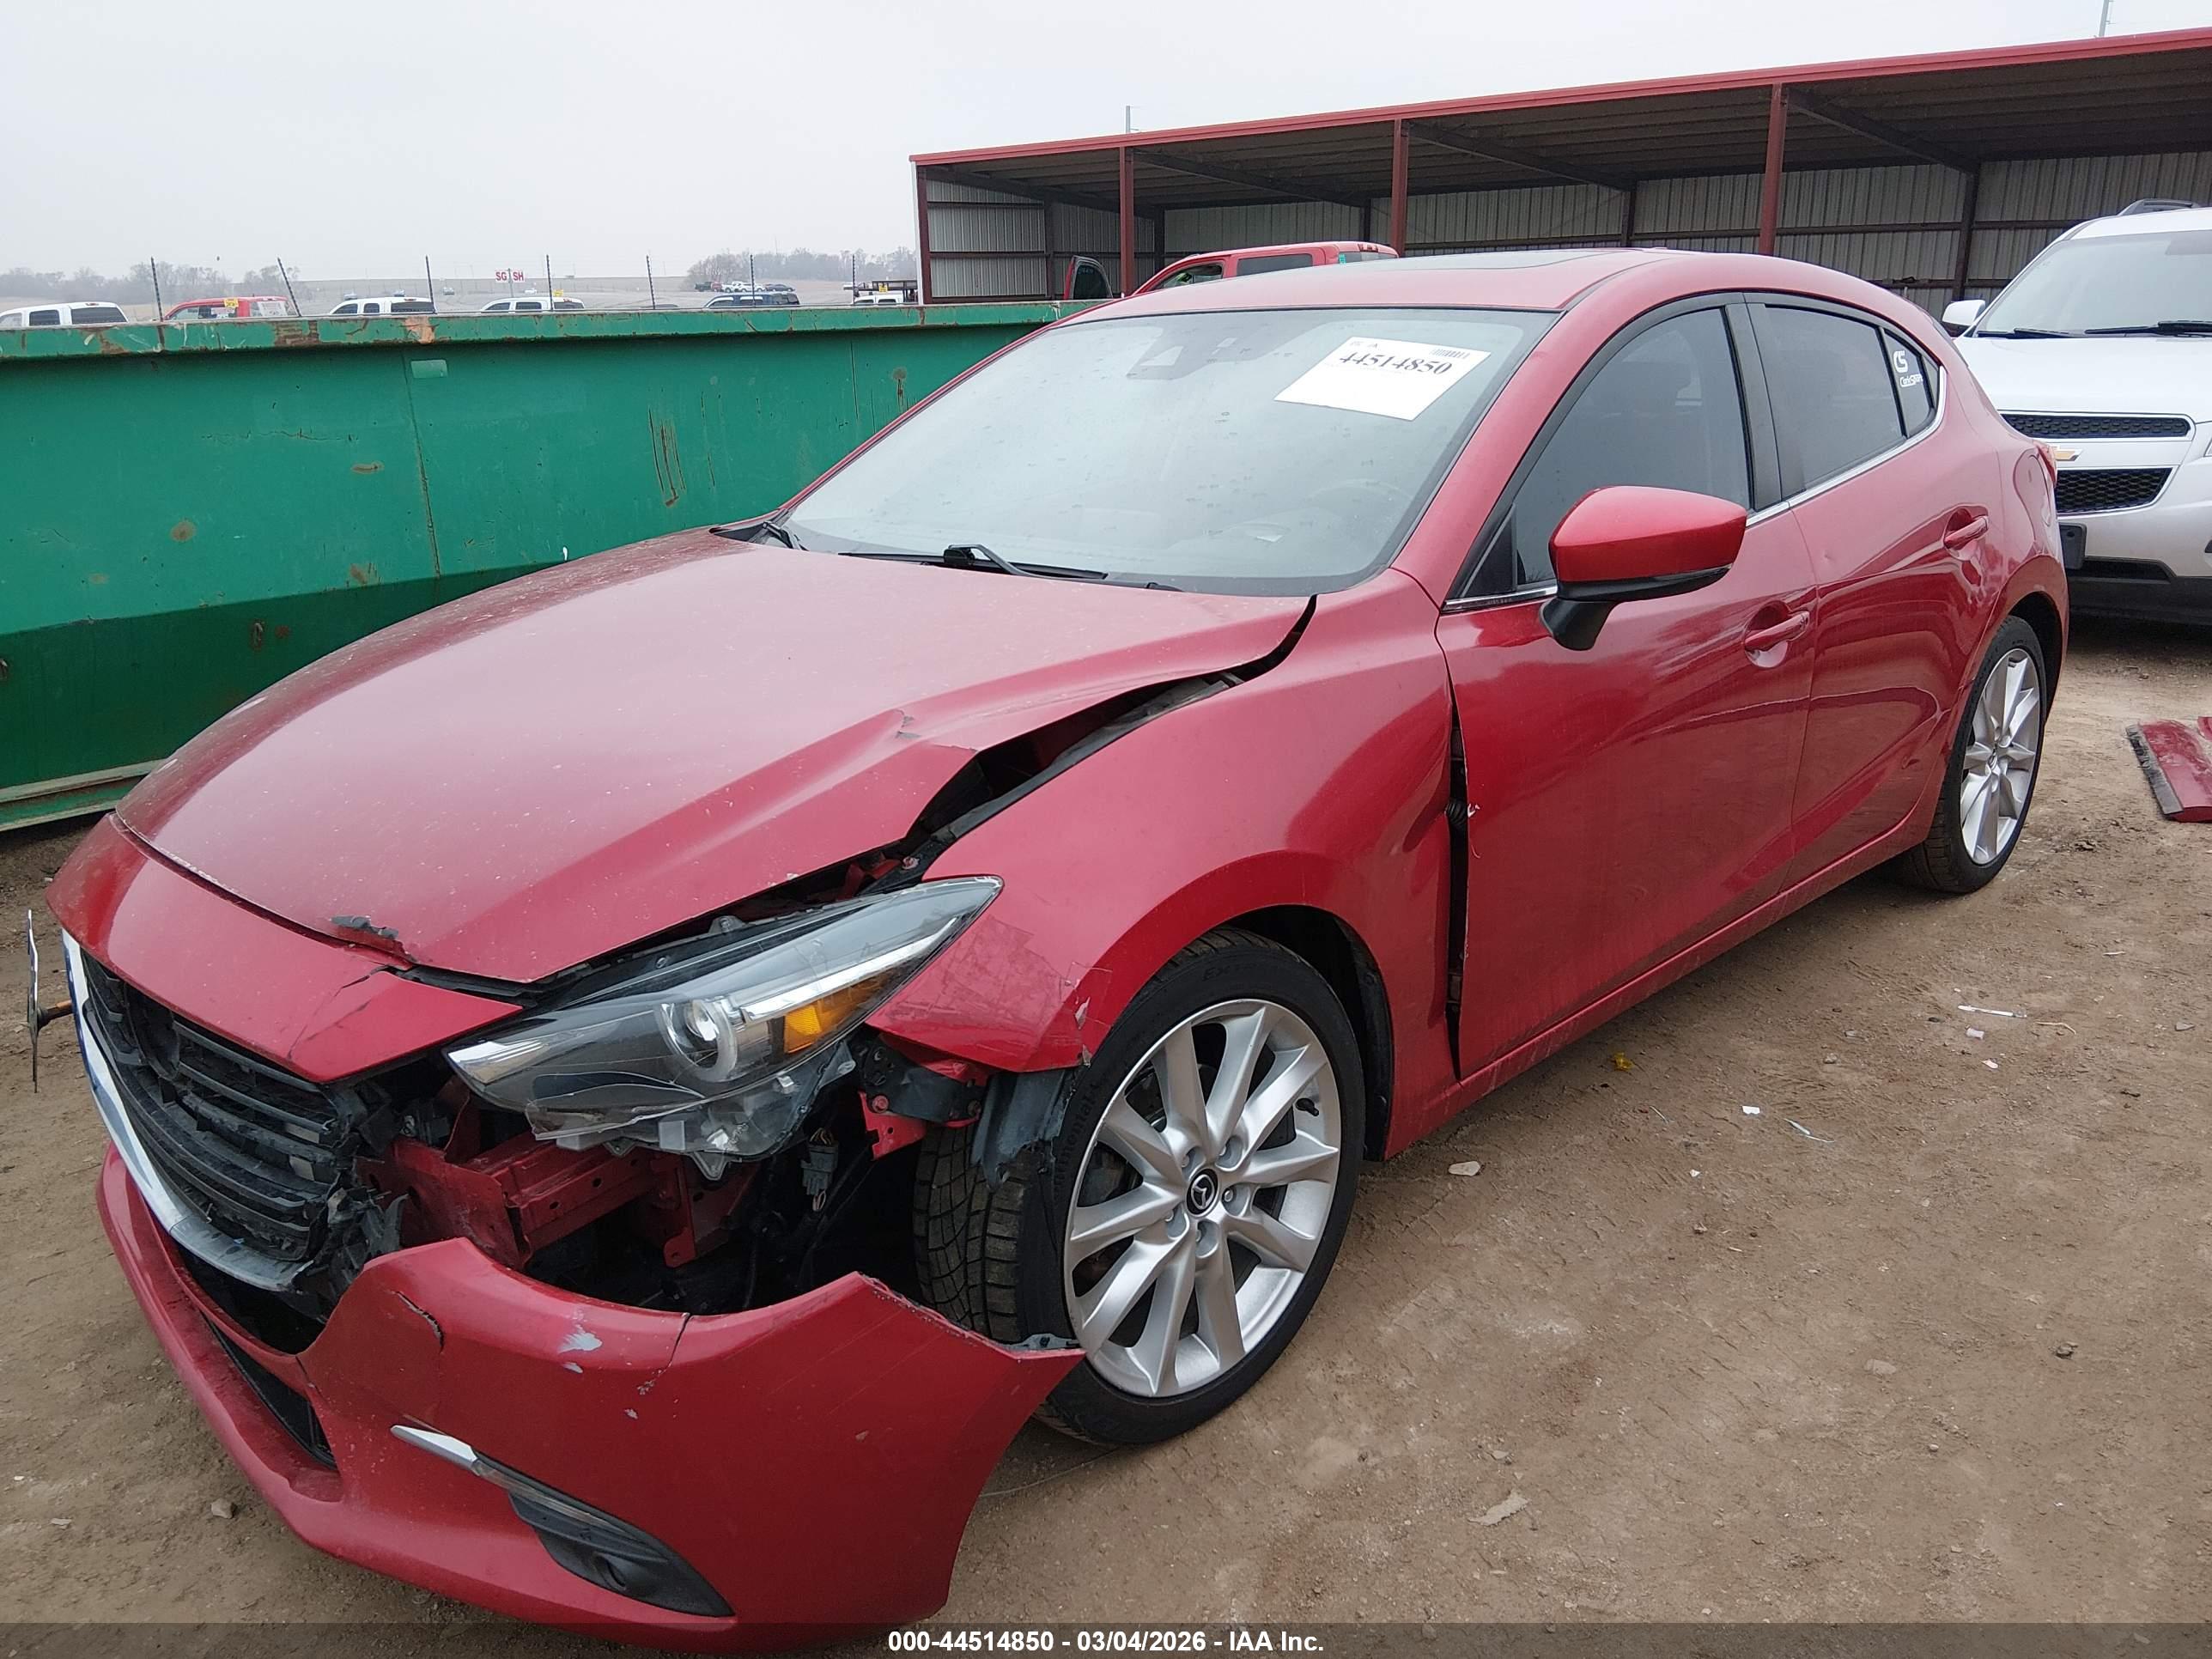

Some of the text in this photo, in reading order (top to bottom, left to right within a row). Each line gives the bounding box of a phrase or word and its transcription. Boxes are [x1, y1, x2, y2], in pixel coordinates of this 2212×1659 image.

[495, 271, 507, 281] SG
[513, 271, 524, 281] SH
[1339, 350, 1453, 374] 44514850
